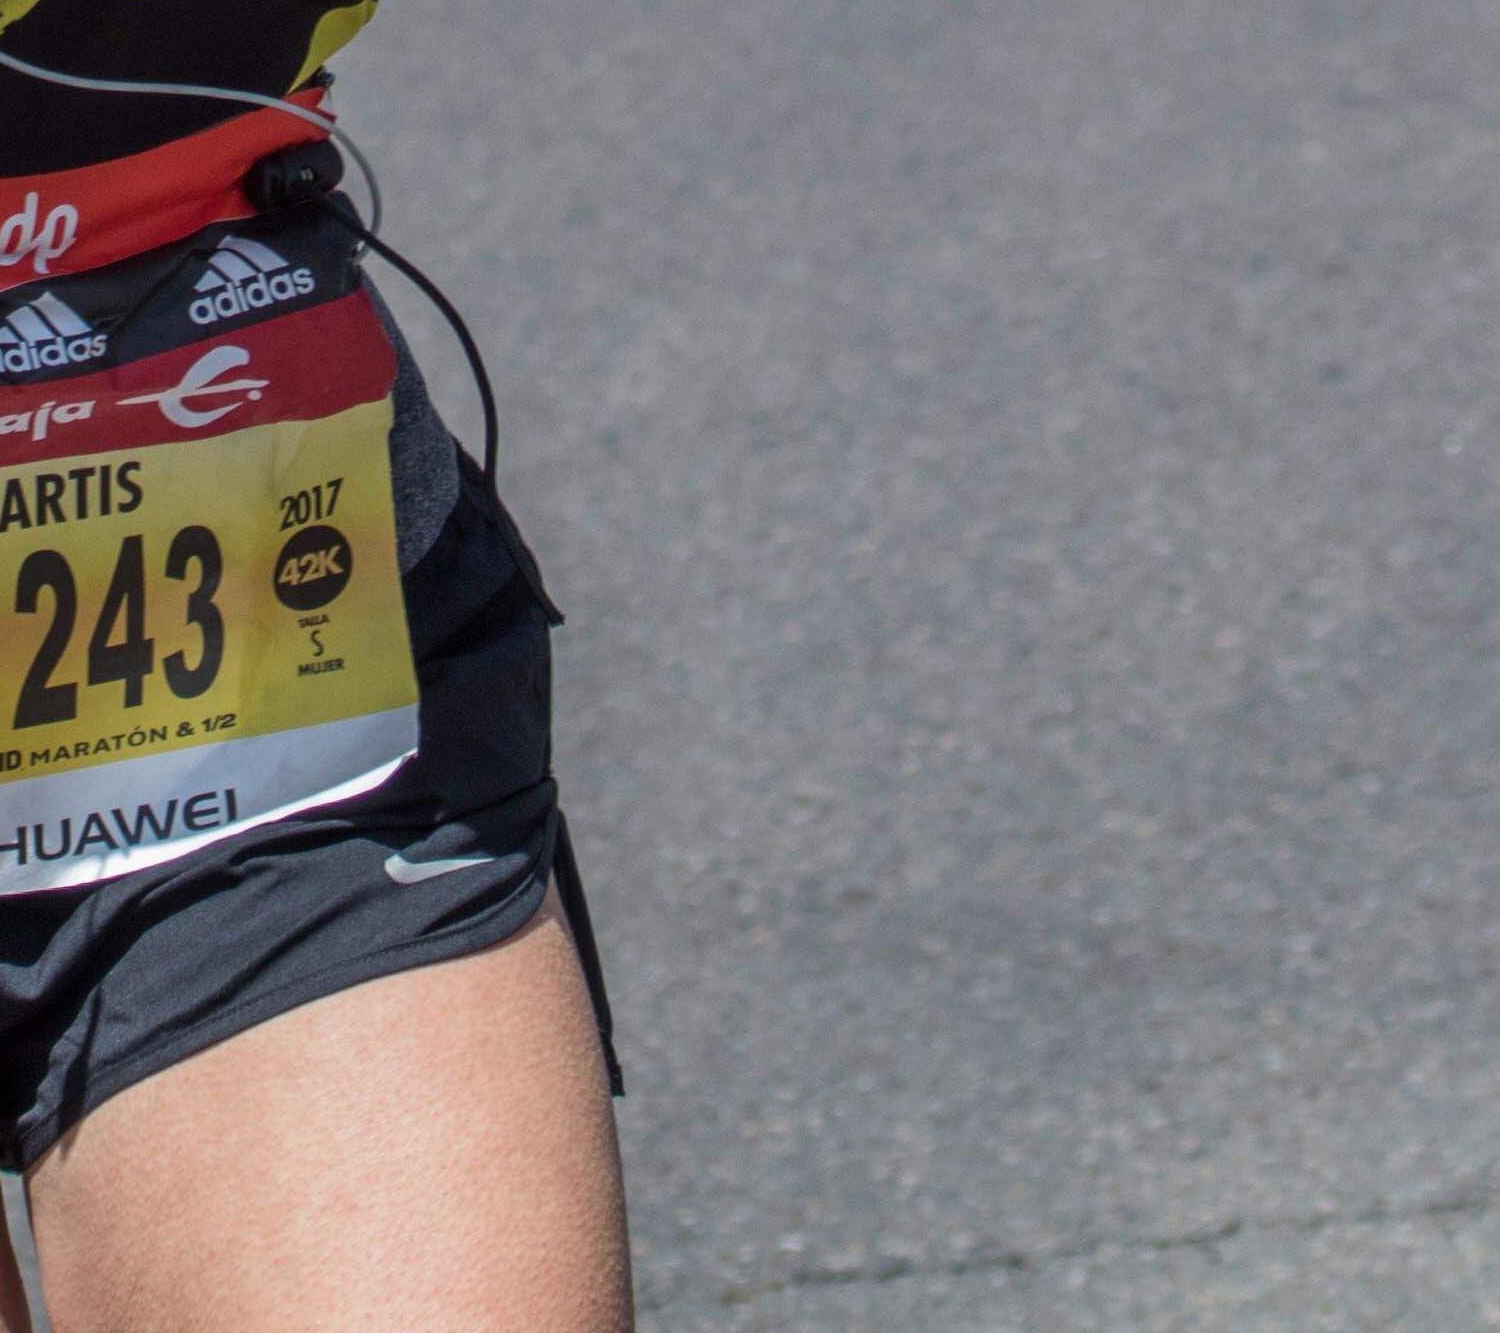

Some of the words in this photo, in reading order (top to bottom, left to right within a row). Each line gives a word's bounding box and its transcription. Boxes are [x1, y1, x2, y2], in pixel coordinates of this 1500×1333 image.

[189, 265, 316, 325] adidas
[279, 477, 345, 532] 2017
[277, 545, 344, 586] 42K
[297, 658, 345, 677] MUJER
[309, 630, 325, 657] S
[29, 723, 169, 767] MARATÓN
[175, 721, 196, 739] &
[201, 712, 238, 732] 1/2
